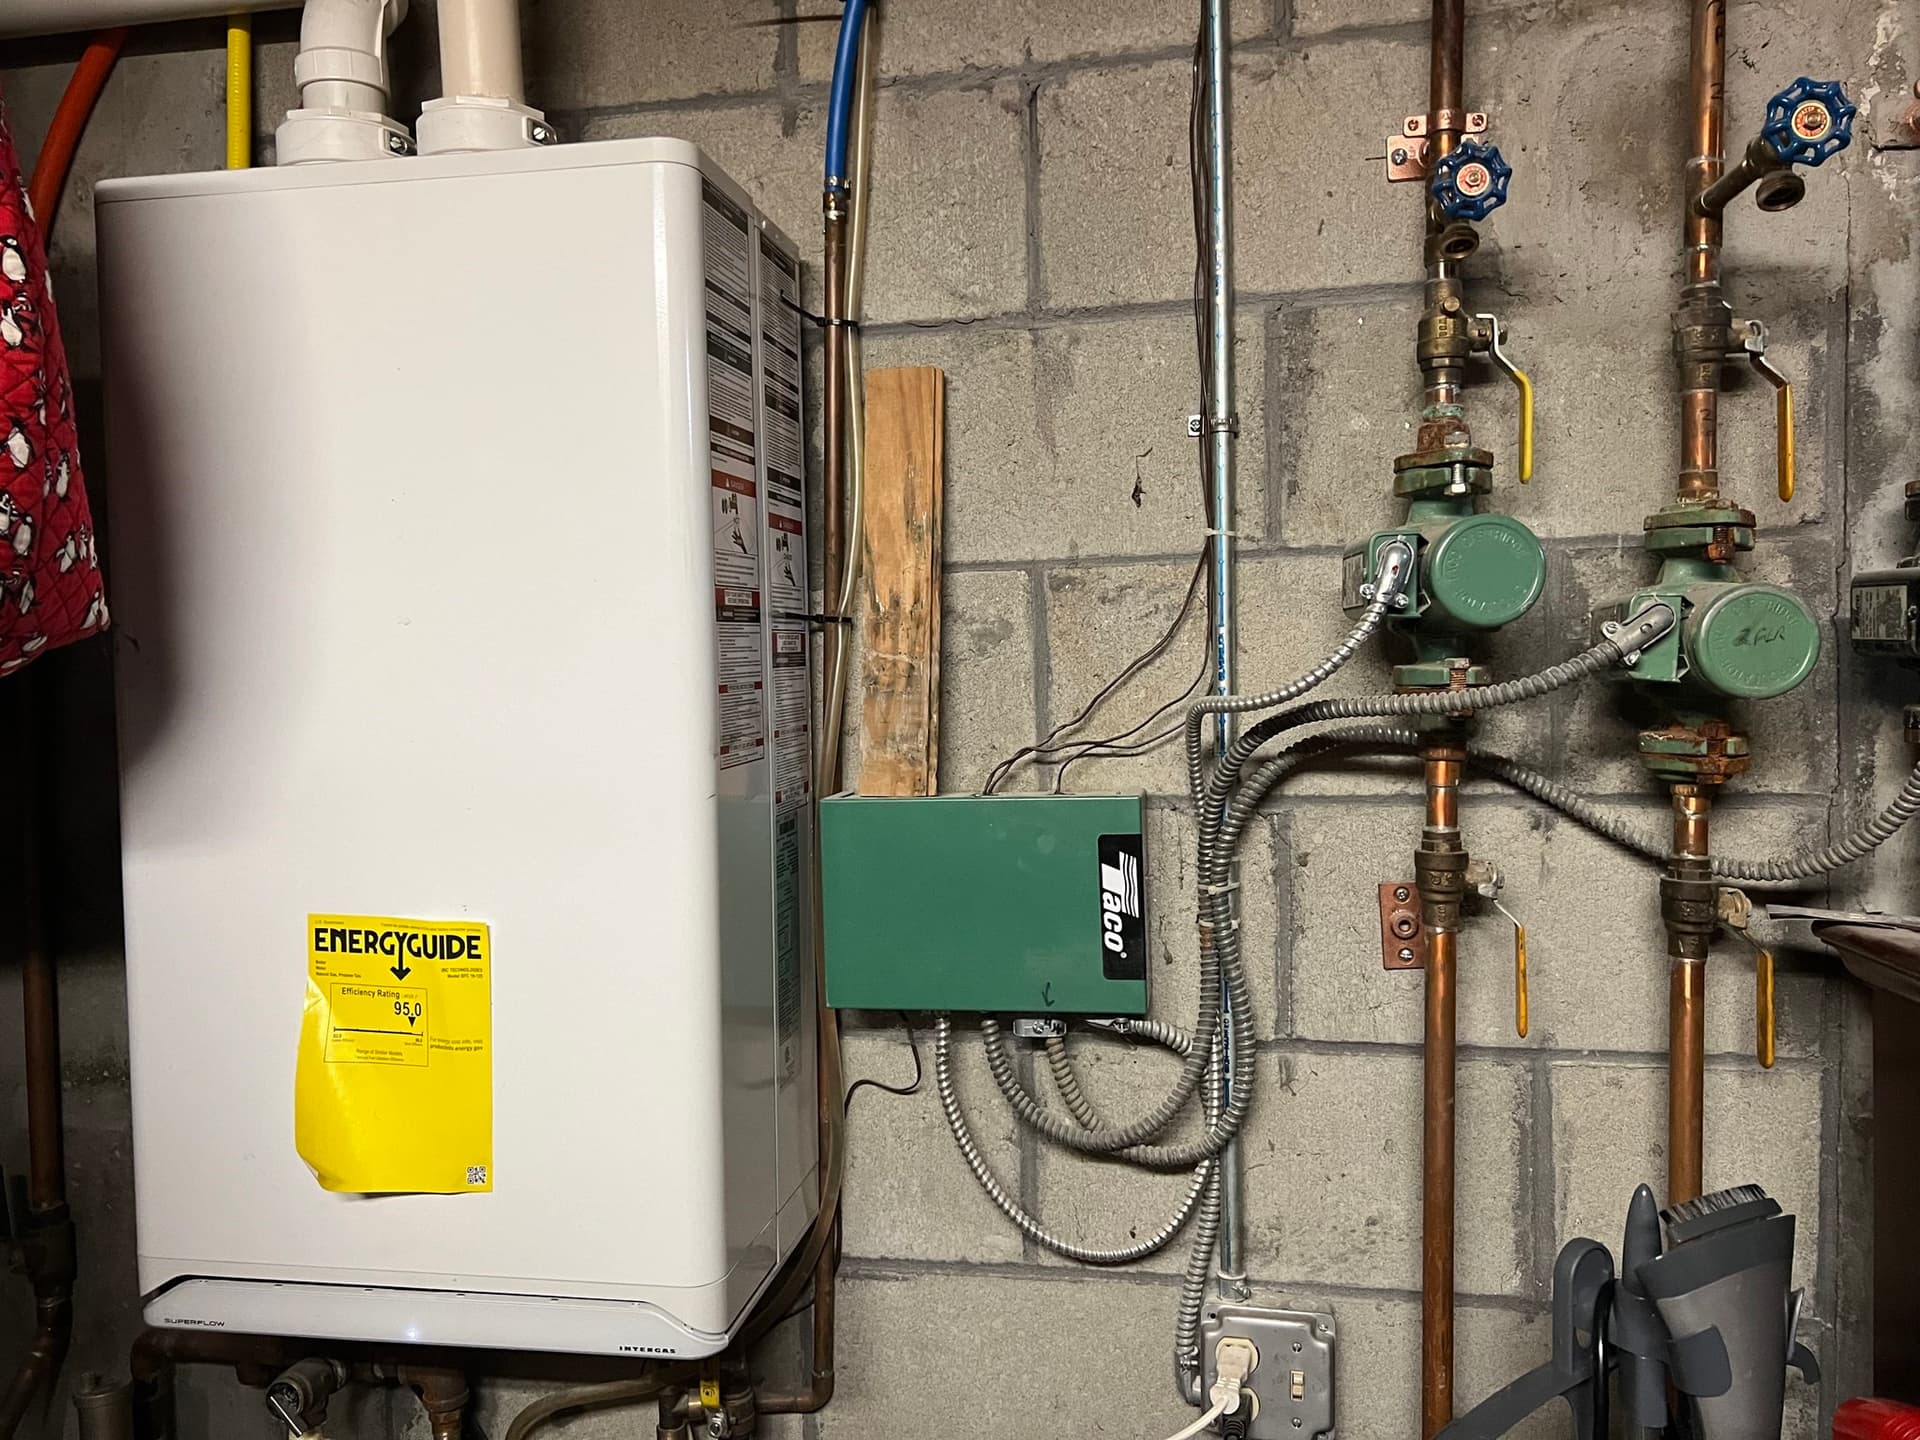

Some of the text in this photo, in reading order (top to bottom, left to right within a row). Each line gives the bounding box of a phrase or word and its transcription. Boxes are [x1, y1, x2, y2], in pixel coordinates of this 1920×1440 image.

[1101, 850, 1140, 954] Taco
[314, 928, 482, 968] ENERGYGUIDE
[341, 987, 376, 998] Efficiency
[377, 989, 401, 999] Rating
[394, 1001, 422, 1017] 95.0
[163, 1317, 226, 1327] SUPERFLOW
[618, 1345, 677, 1354] INTERGAS
